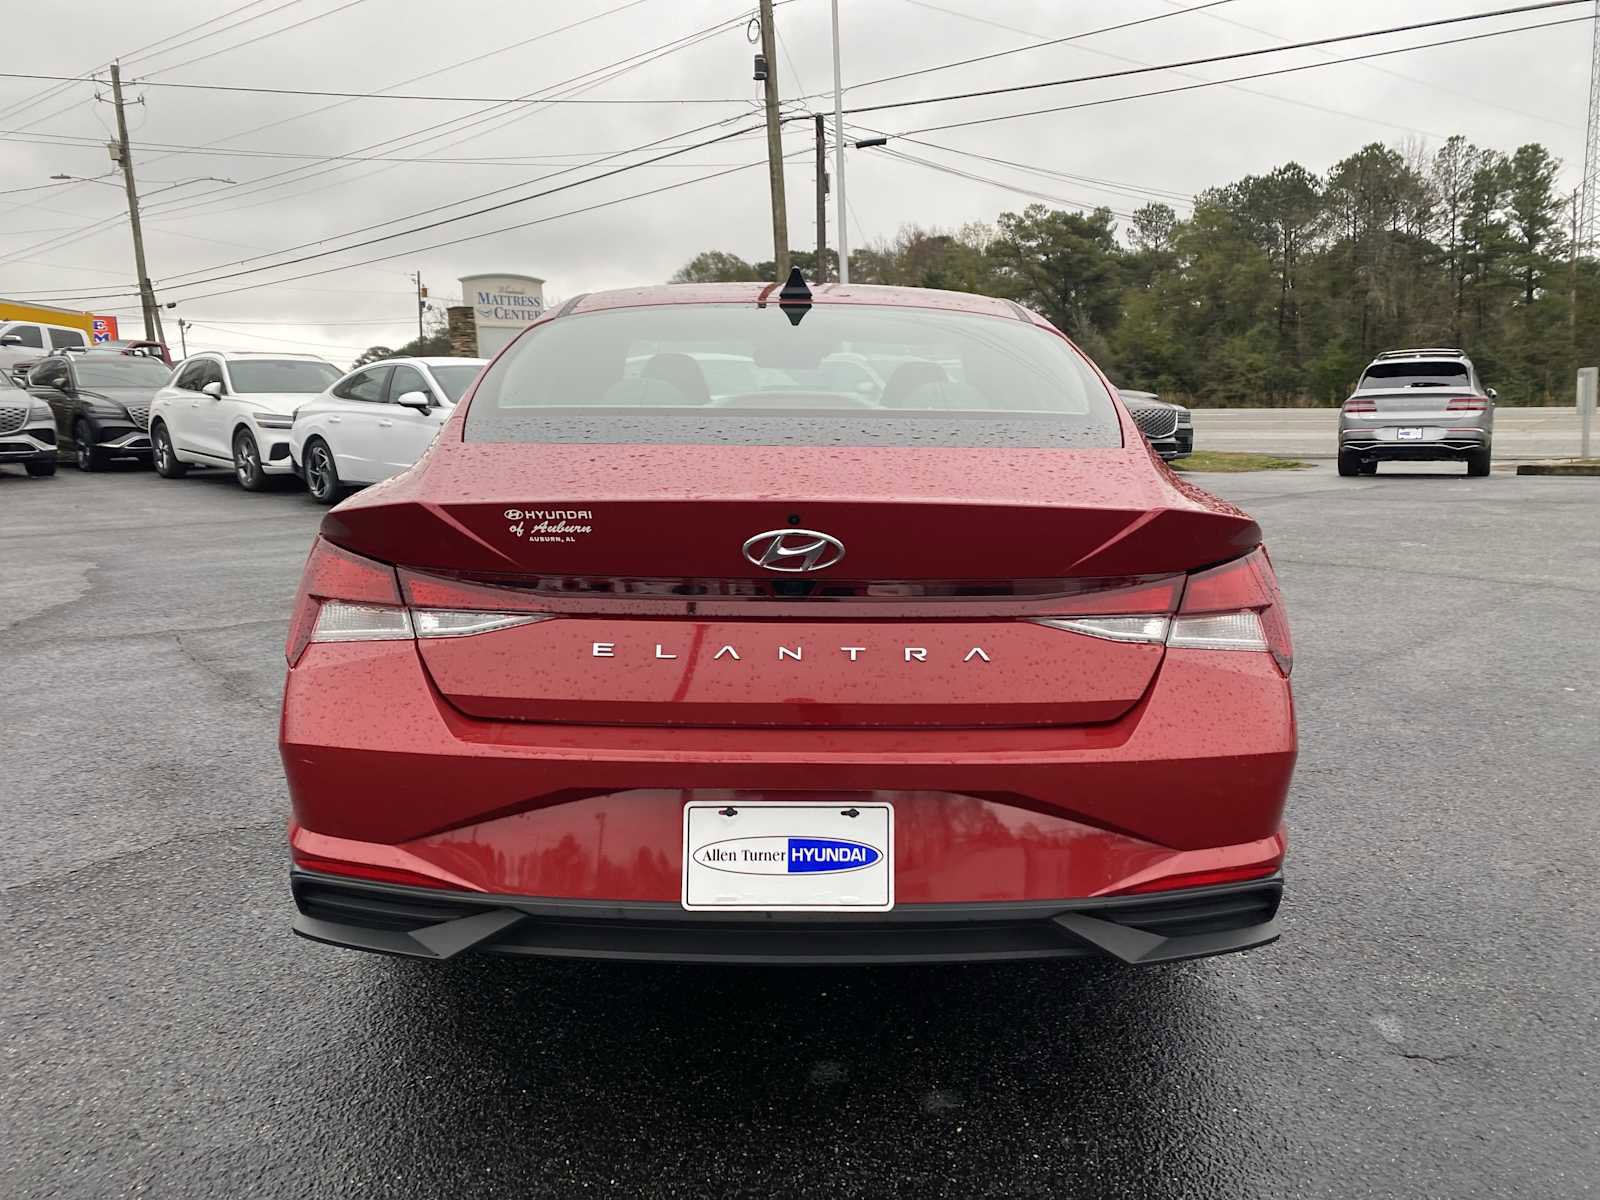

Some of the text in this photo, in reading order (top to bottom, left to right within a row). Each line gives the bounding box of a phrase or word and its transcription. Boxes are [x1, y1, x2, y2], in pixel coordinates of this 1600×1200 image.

[478, 291, 541, 307] MATTRESS
[524, 510, 593, 520] HYUNDAI
[509, 520, 592, 537] of Auburn
[592, 642, 991, 662] ELANTRA
[702, 847, 867, 862] Allen Turner HYUNDAI
